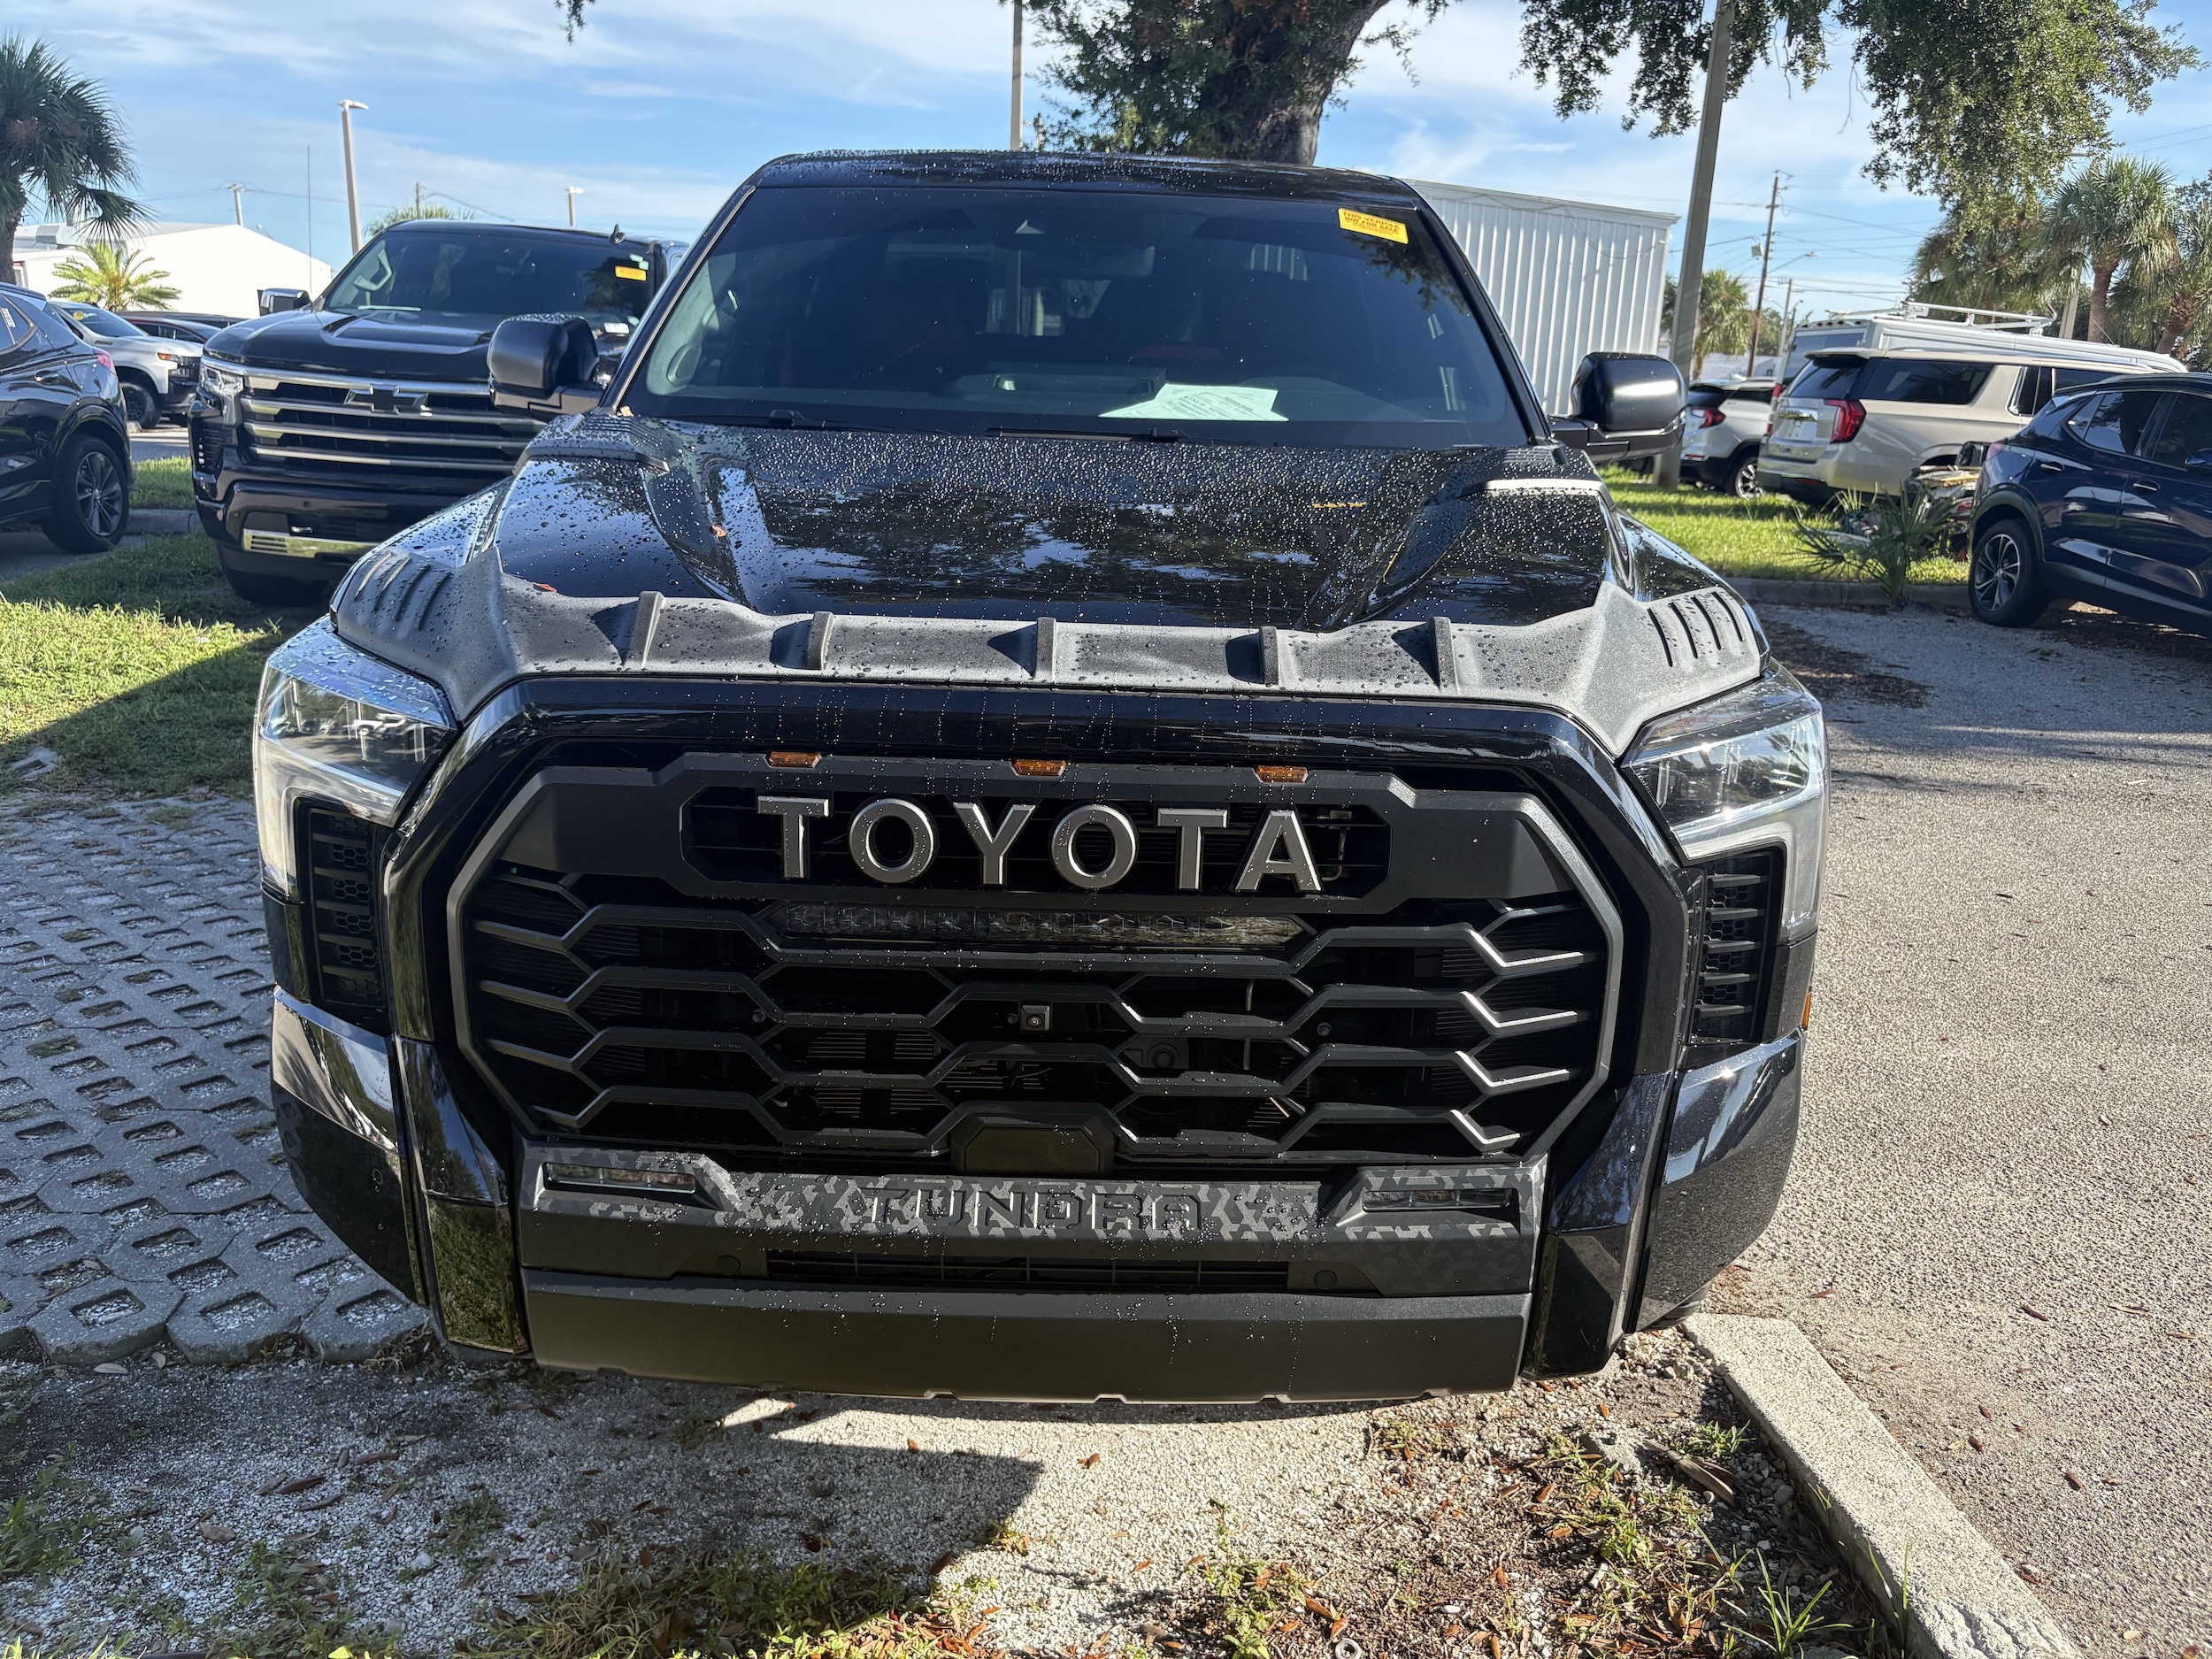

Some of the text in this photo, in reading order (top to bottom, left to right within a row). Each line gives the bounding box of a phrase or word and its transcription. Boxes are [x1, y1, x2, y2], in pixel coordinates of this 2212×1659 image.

[1363, 217, 1399, 228] VEHICLE
[757, 795, 1323, 893] TOYOTA
[856, 1187, 1202, 1231] TUNDRA
